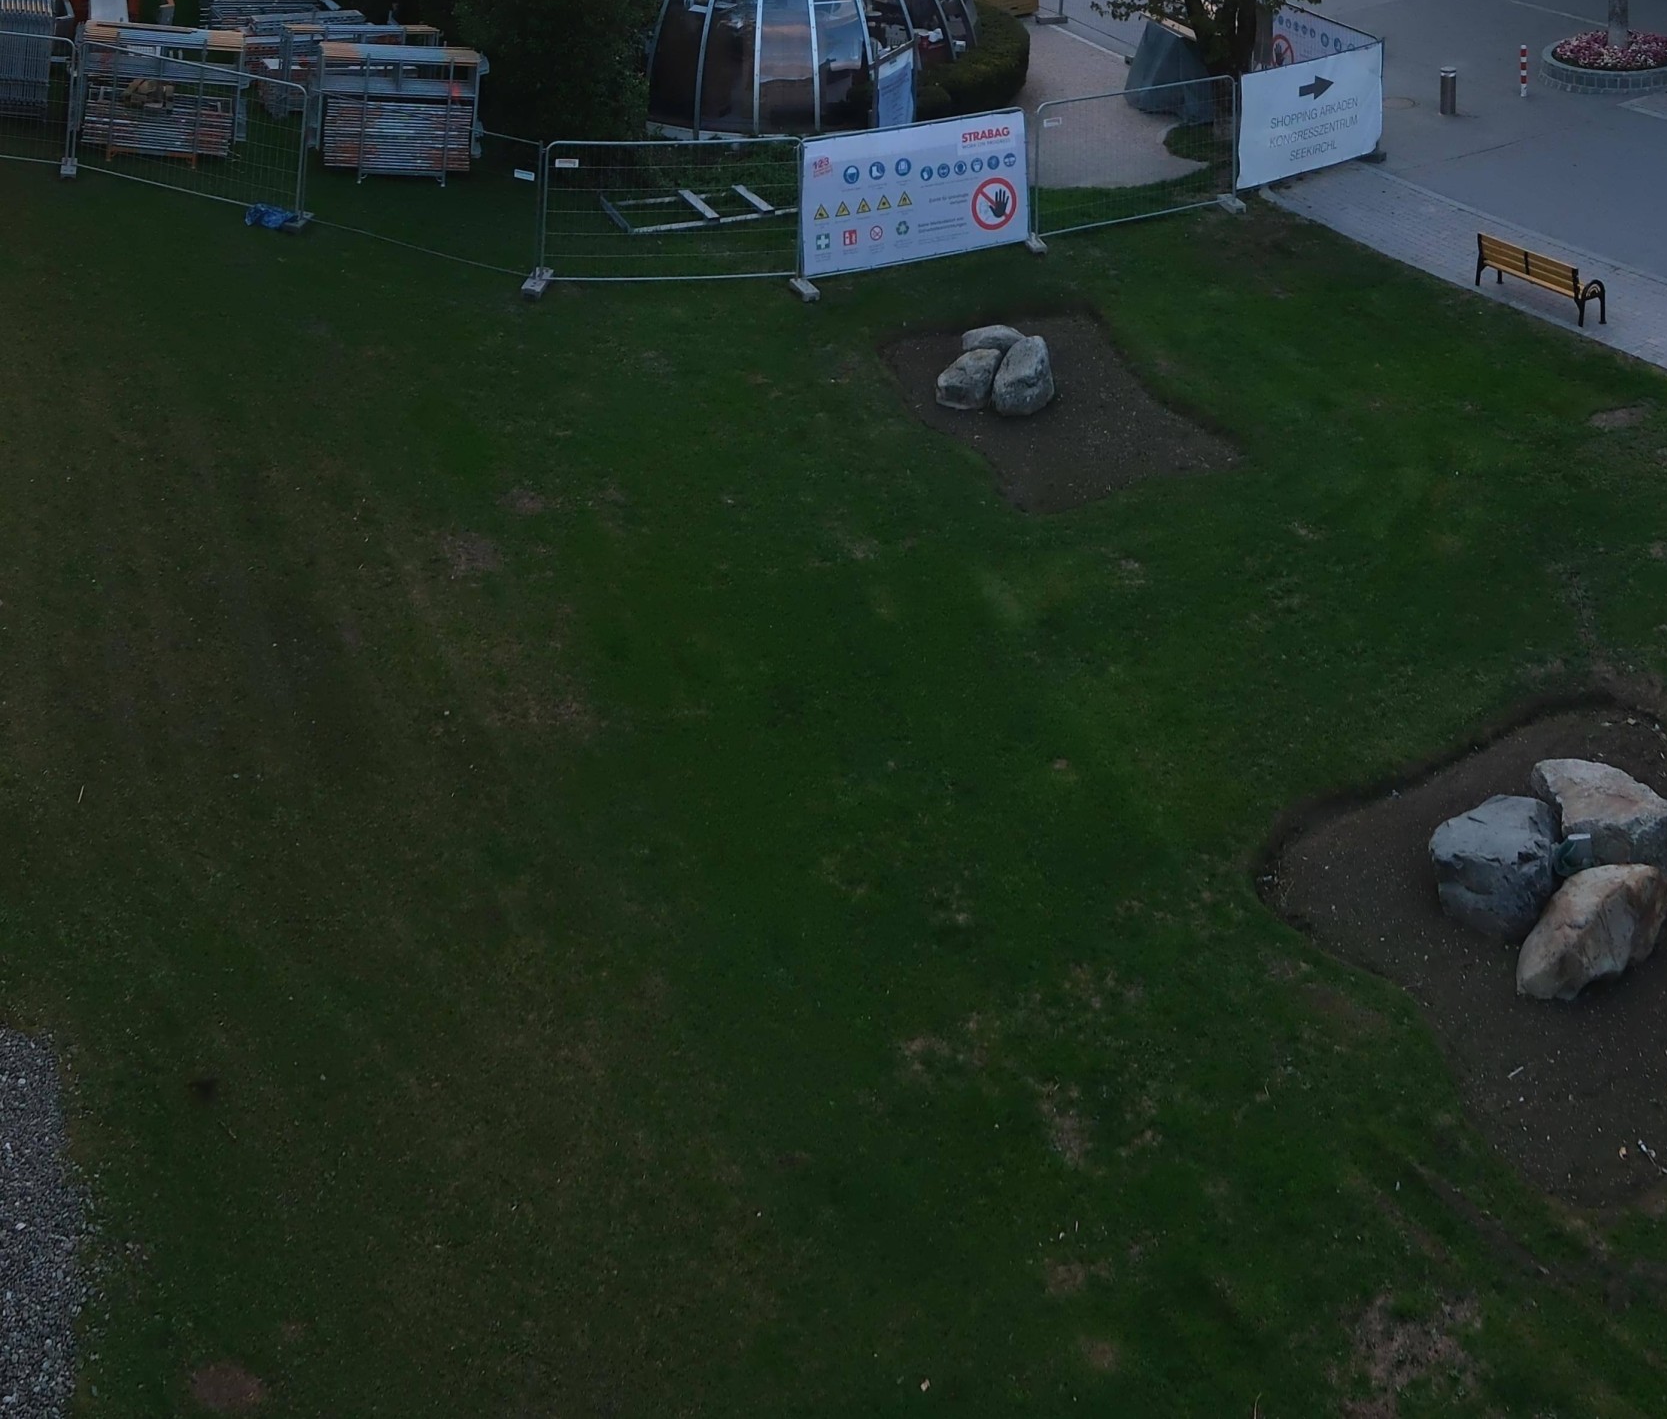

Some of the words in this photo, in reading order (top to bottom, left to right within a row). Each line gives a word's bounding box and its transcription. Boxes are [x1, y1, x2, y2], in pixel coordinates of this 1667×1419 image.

[1270, 108, 1318, 129] SHOPPING
[1319, 96, 1358, 119] ARKADEN
[961, 127, 1010, 143] STRABAG
[1269, 114, 1358, 148] KONGRESSZENTRUM
[1289, 140, 1337, 161] SEEKIRCHL
